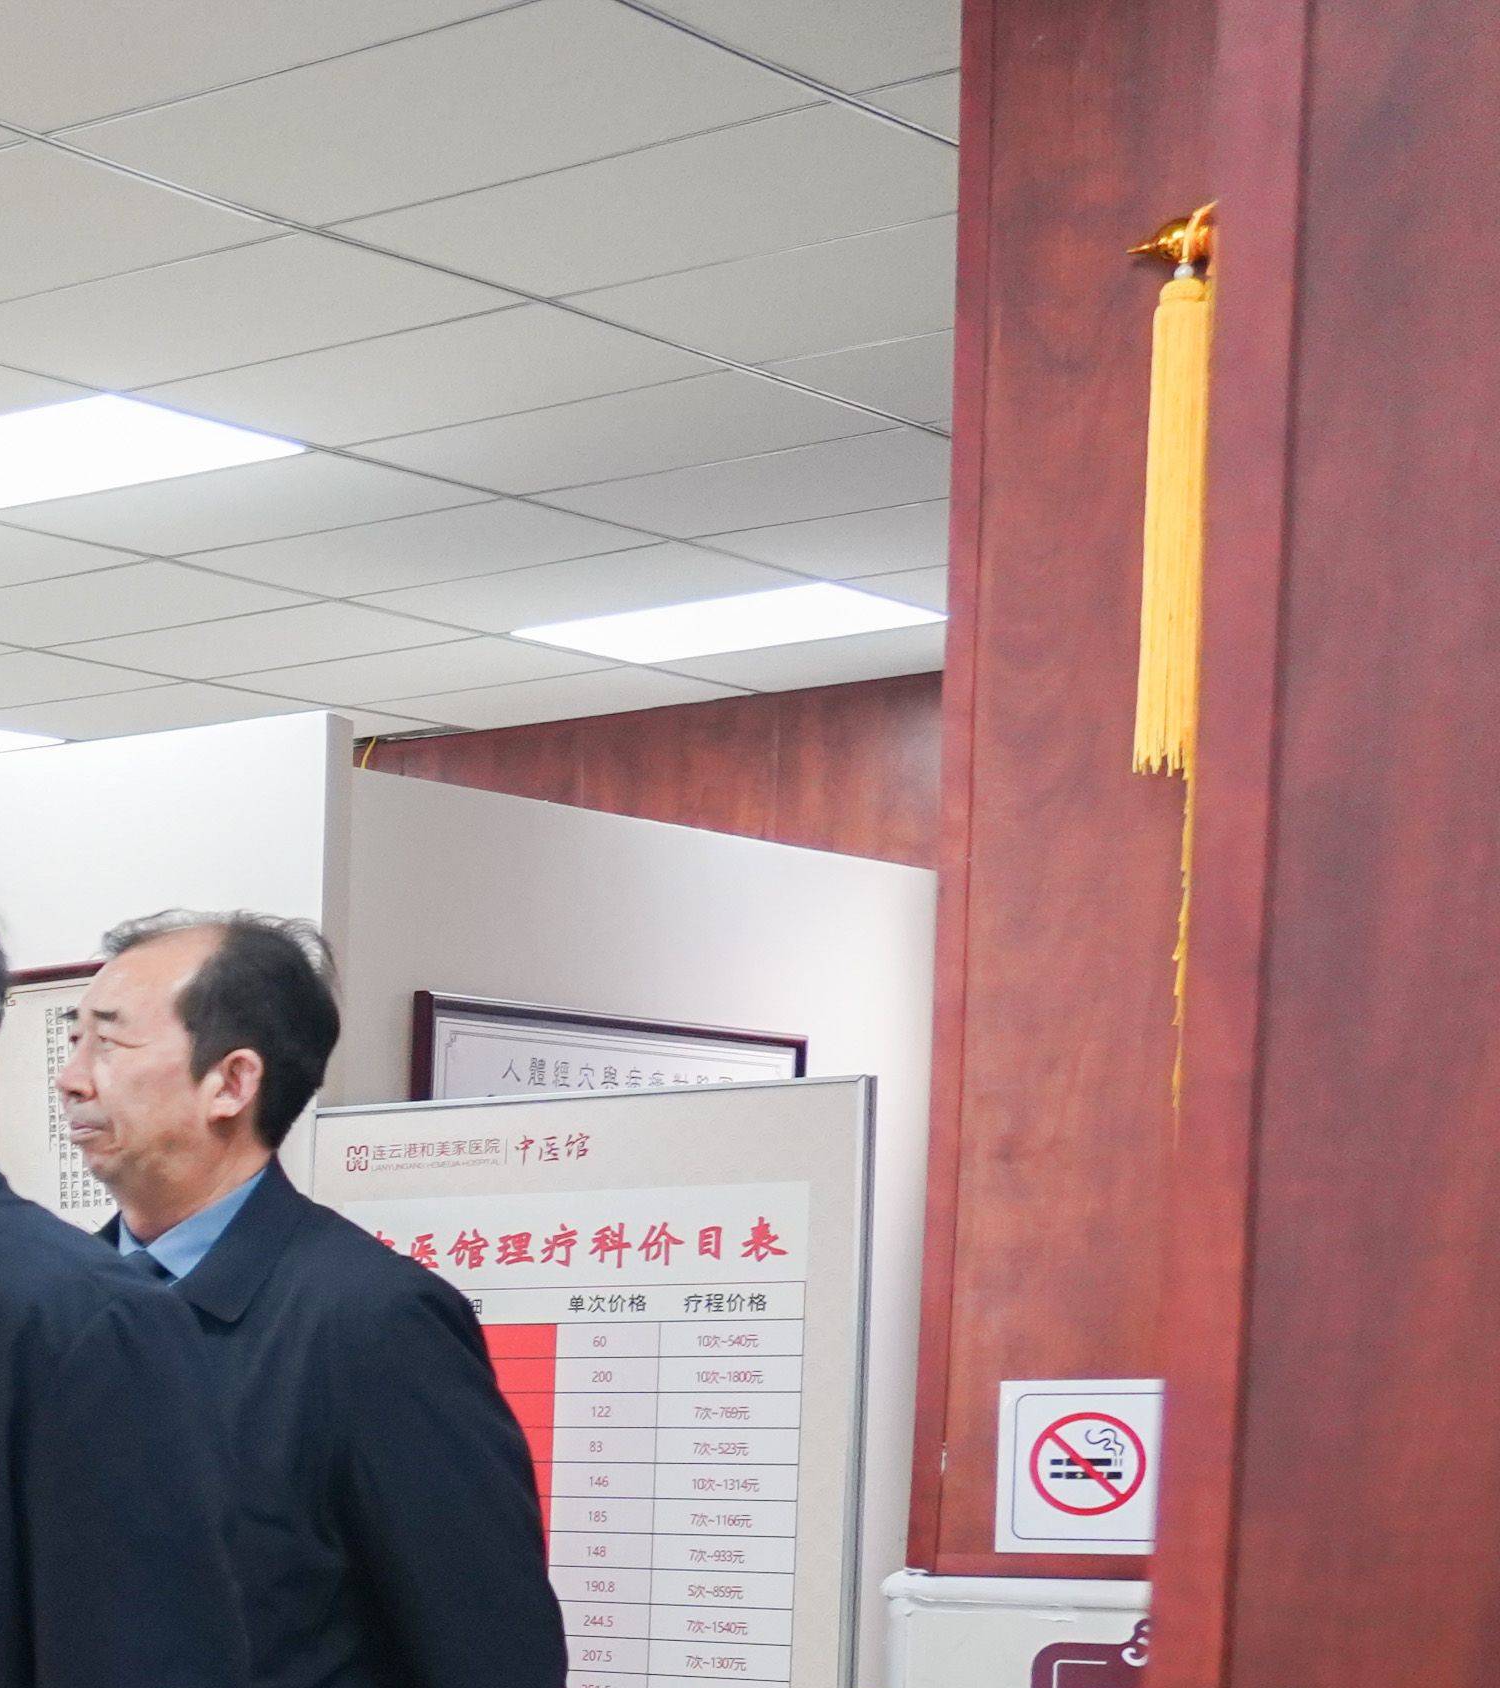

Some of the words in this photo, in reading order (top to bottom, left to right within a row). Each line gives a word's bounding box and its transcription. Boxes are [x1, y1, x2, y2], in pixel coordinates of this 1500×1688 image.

[515, 1132, 592, 1164] 中医馆
[568, 1294, 647, 1314] 单次价格
[684, 1292, 768, 1314] 疗程价格
[591, 1336, 607, 1347] 60
[591, 1371, 612, 1383] 200
[590, 1406, 611, 1418] 122
[589, 1441, 603, 1452] 83
[588, 1476, 609, 1488] 146
[586, 1511, 607, 1522] 185
[585, 1546, 606, 1558] 148
[584, 1581, 615, 1593] 190.8
[583, 1615, 613, 1627] 244.5
[581, 1650, 612, 1662] 207.5
